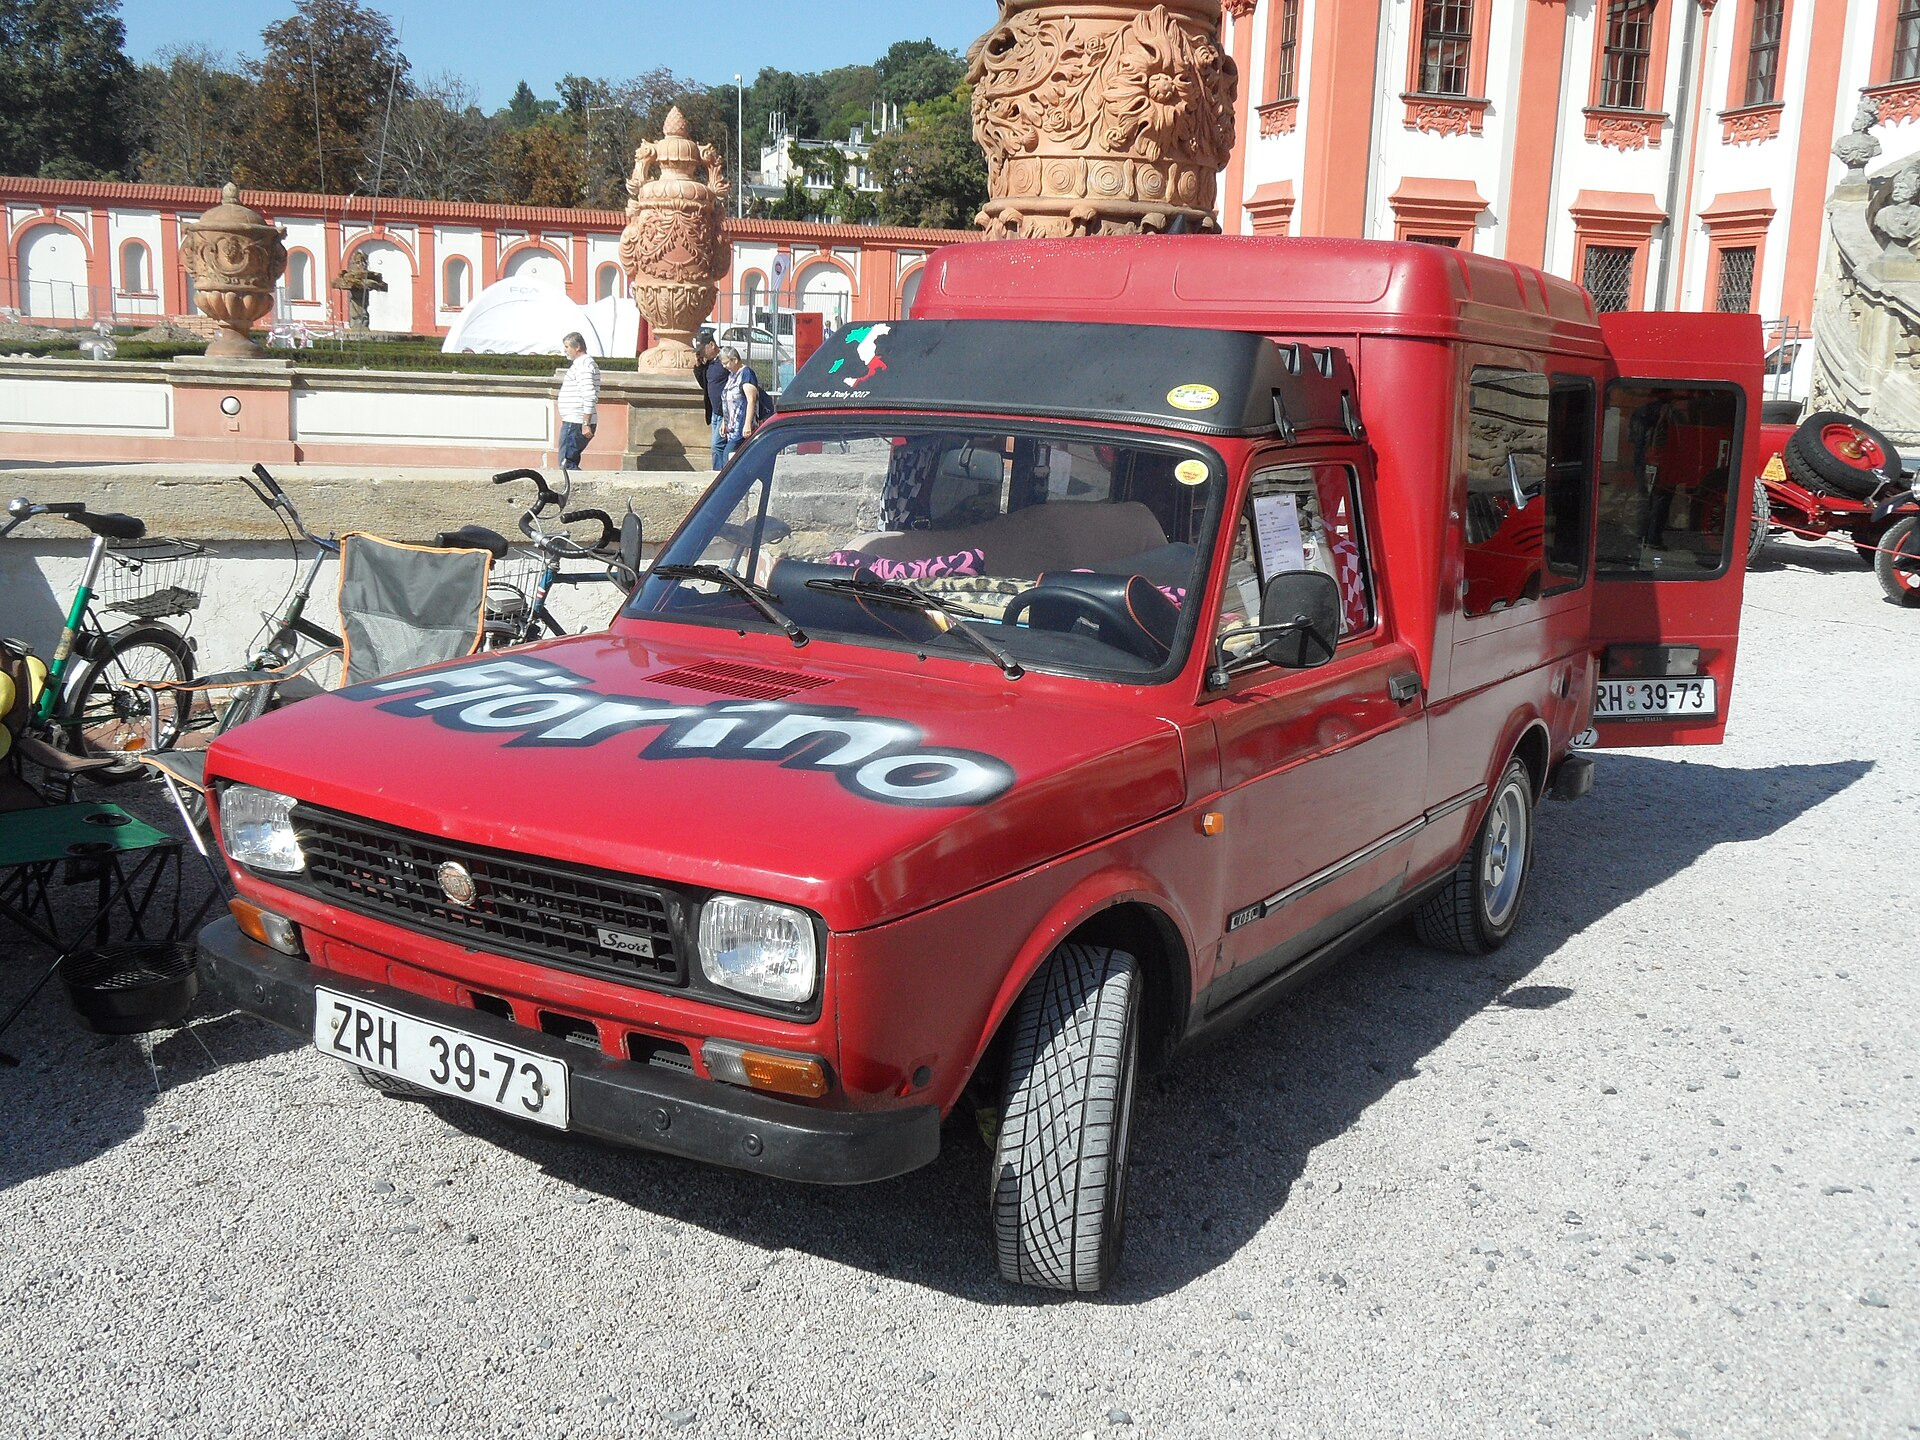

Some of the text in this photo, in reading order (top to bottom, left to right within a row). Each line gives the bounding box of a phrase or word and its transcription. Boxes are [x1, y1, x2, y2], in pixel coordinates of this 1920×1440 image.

[831, 390, 850, 399] Italy
[850, 390, 871, 398] 2017
[1640, 683, 1704, 710] 39-73
[364, 658, 1006, 804] Fiorino
[603, 933, 649, 953] Sport
[332, 1001, 545, 1113] ZRH 39-73
